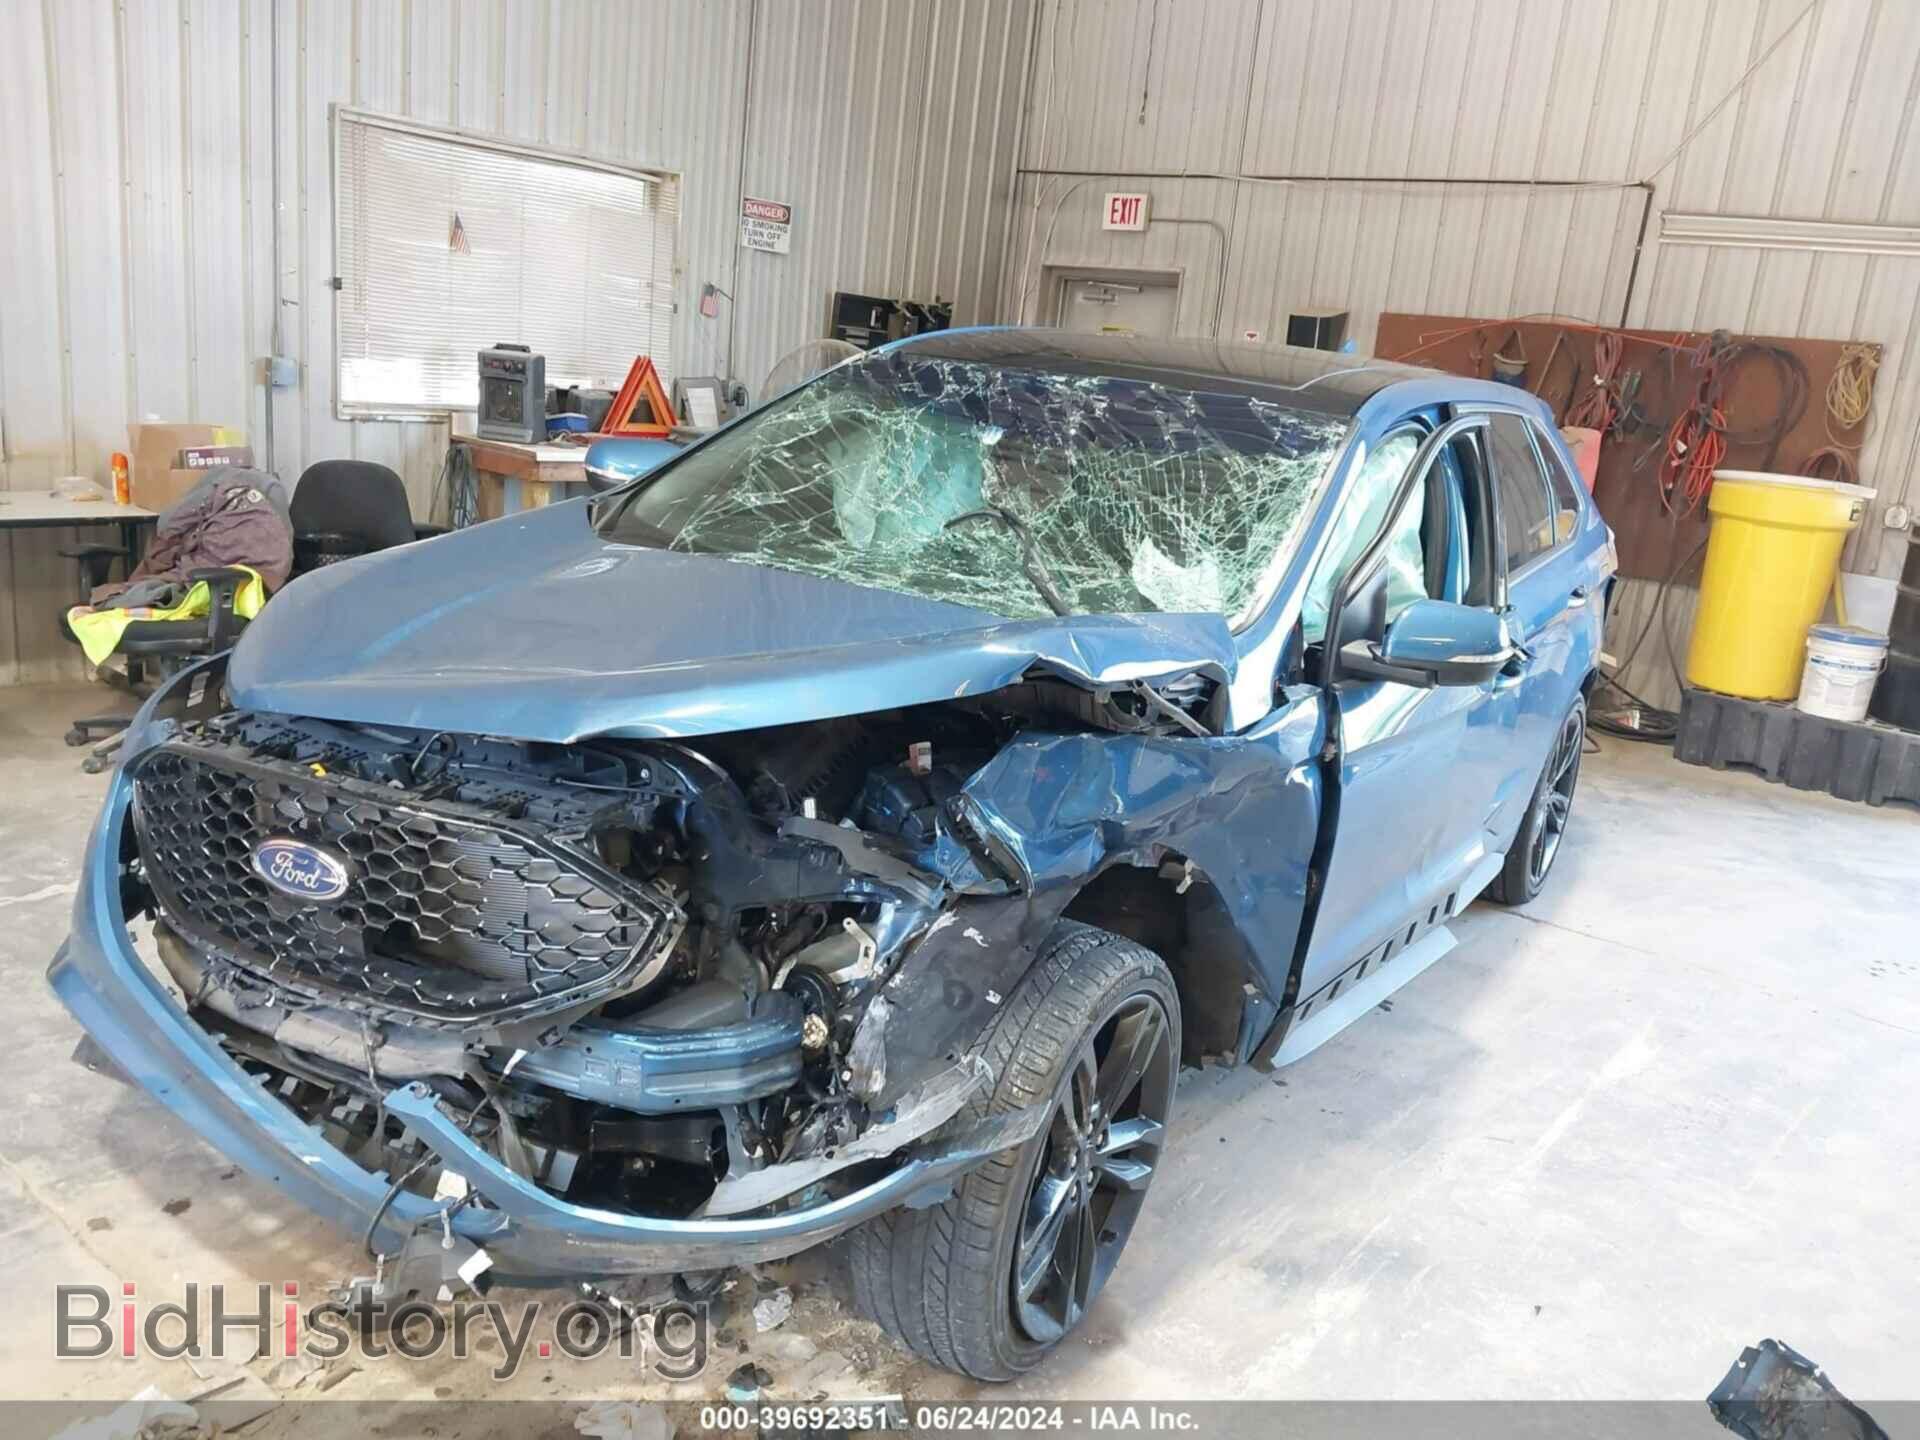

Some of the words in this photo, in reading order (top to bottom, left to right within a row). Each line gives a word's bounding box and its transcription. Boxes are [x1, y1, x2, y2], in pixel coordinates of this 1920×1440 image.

[745, 203, 784, 218] DANGER
[1110, 197, 1141, 225] EXIT
[752, 220, 788, 233] SMOKING
[744, 228, 764, 238] TURN
[767, 231, 781, 240] OFF
[747, 238, 776, 249] ENGINE
[270, 851, 321, 889] Ford
